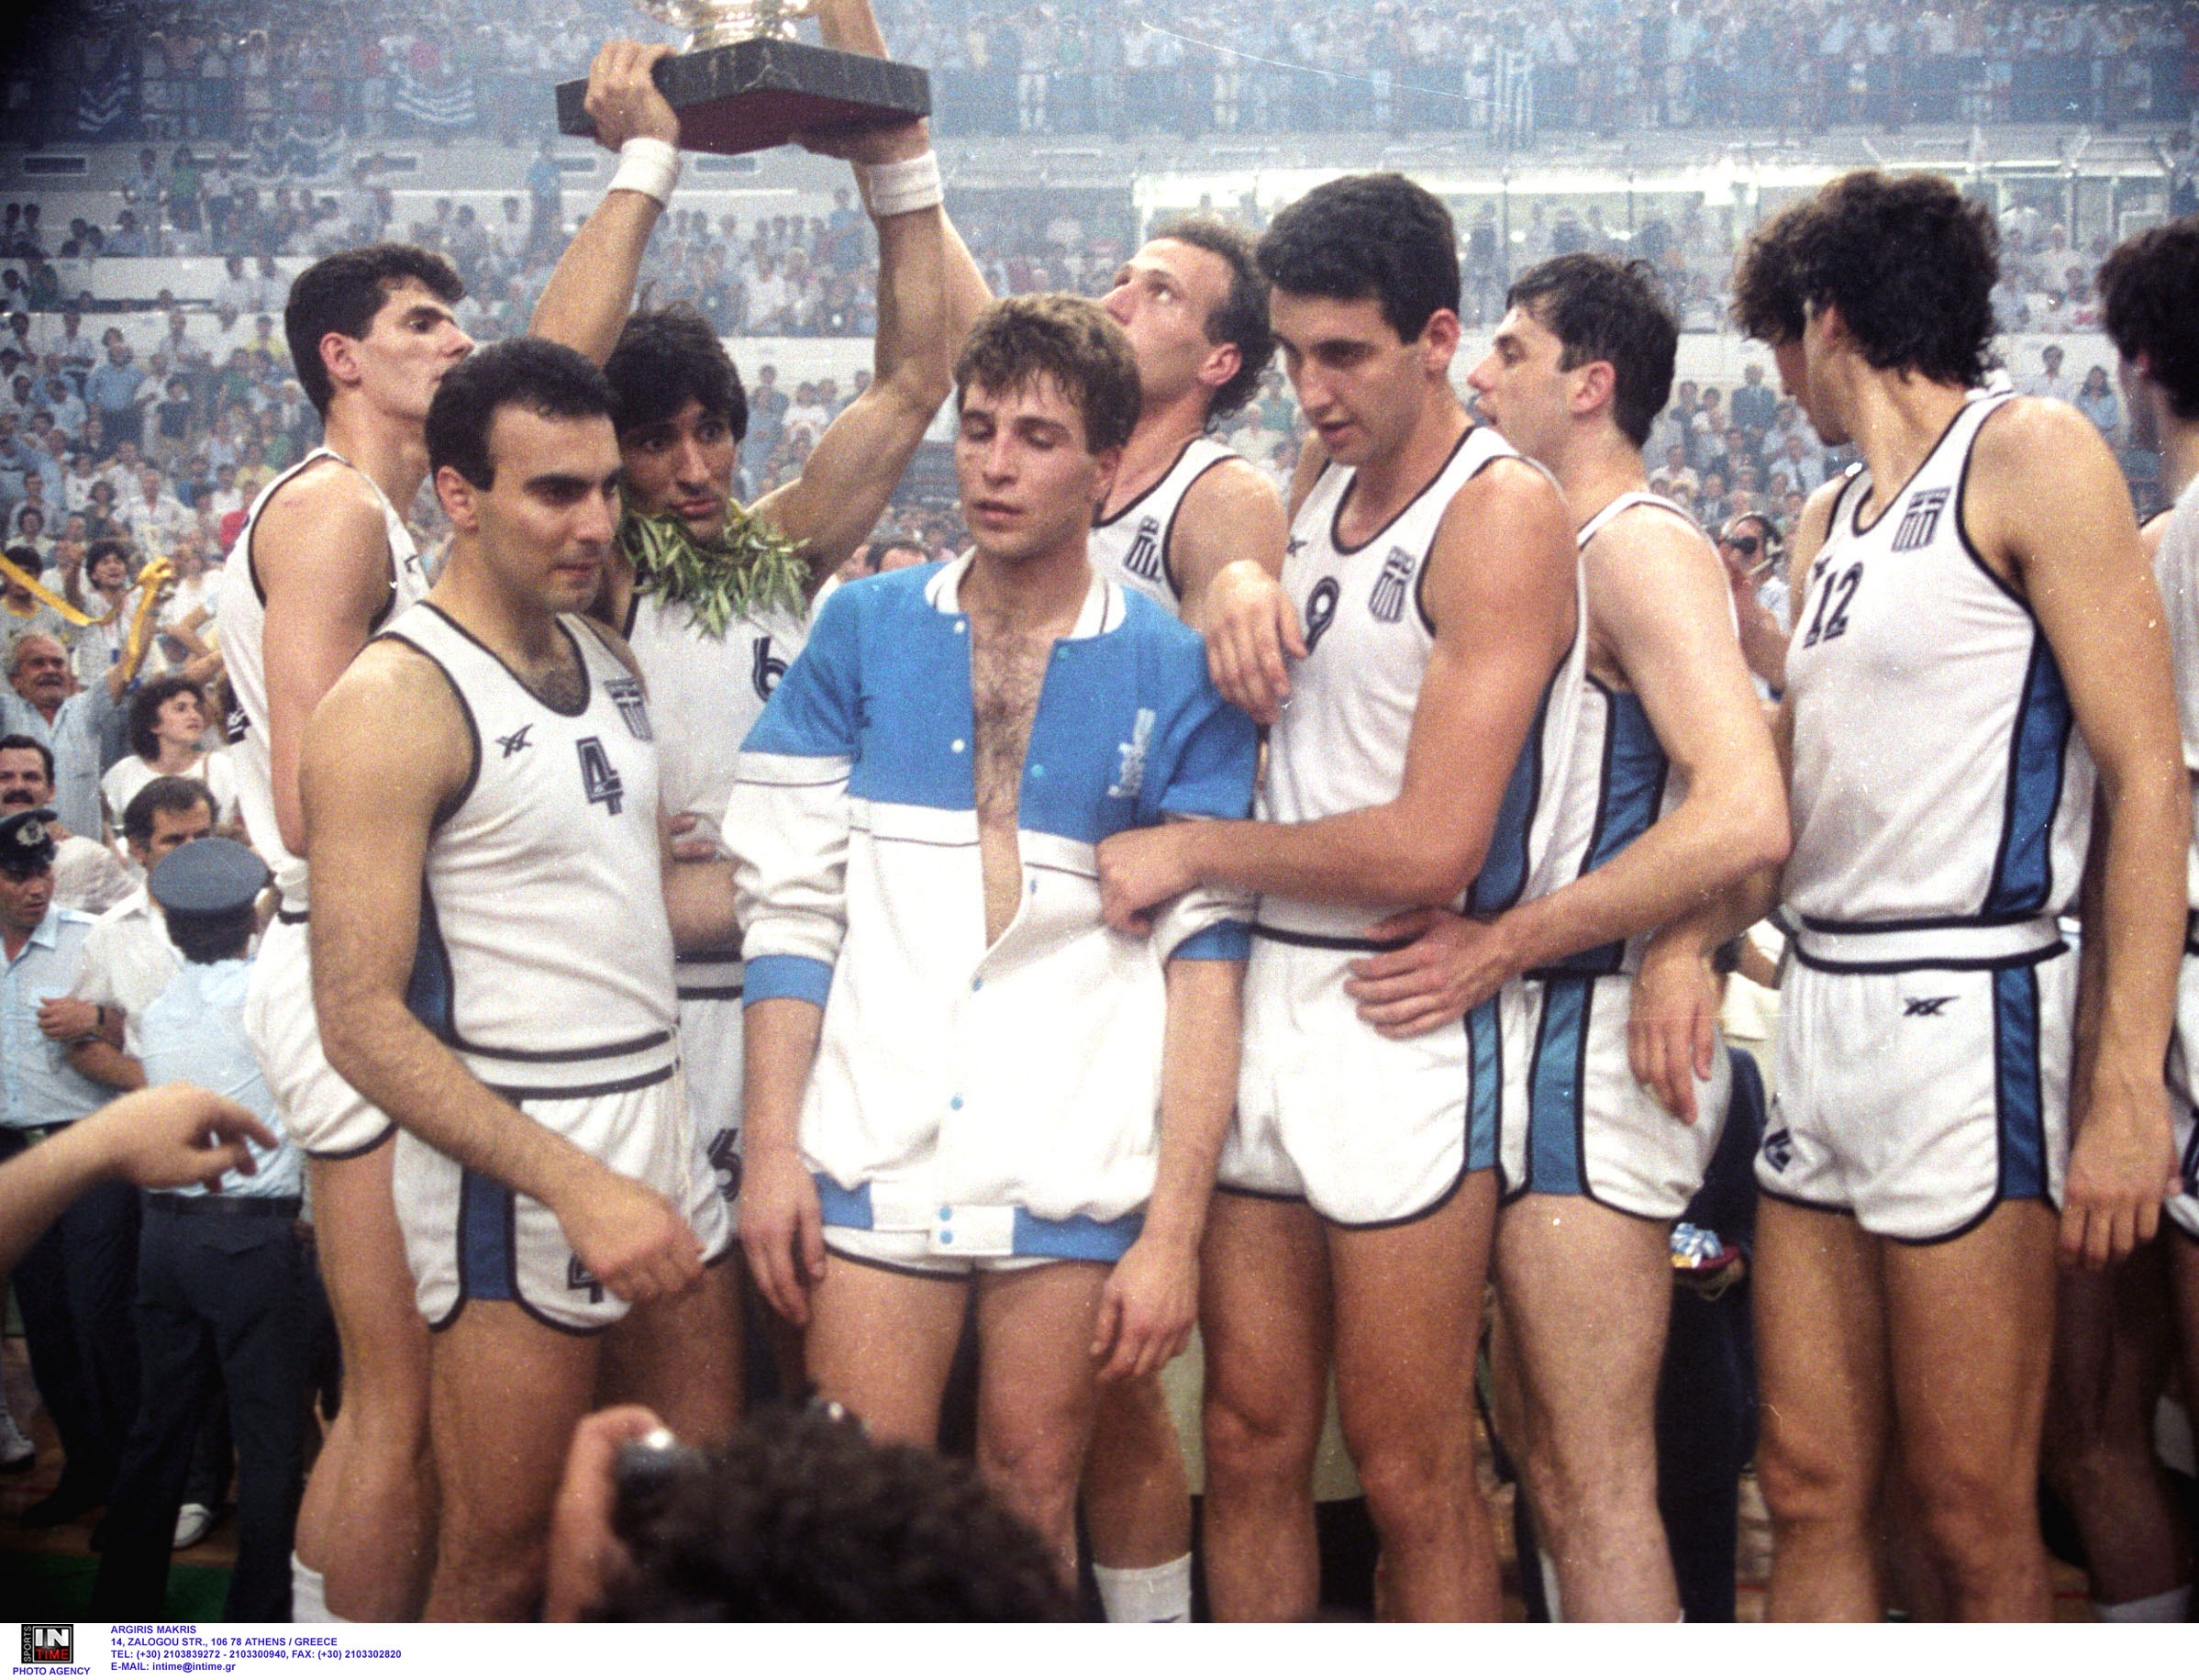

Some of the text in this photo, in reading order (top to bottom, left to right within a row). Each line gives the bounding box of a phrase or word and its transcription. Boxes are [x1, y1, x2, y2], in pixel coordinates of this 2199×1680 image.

[1305, 575, 1340, 656] 9
[1803, 562, 1864, 648] 12
[752, 635, 789, 703] 6
[576, 736, 624, 816] 4
